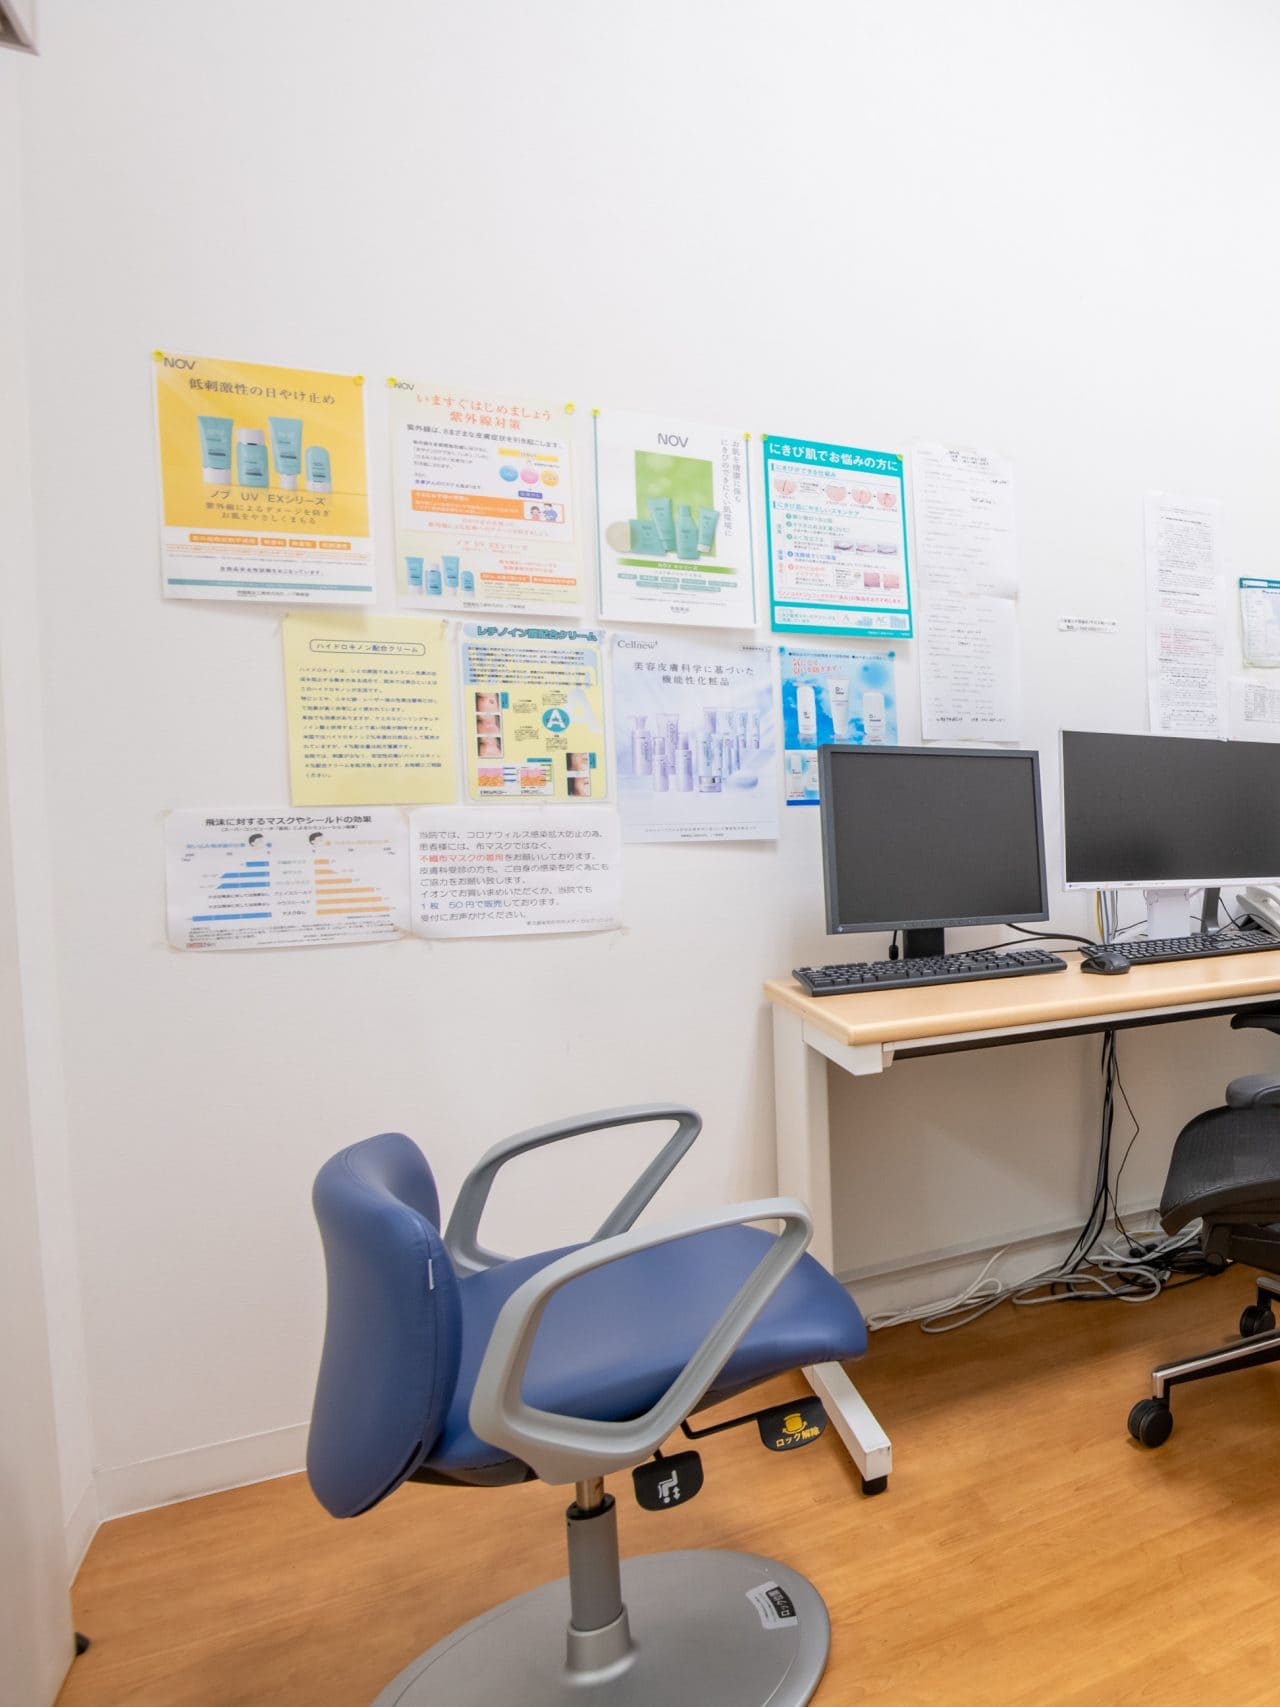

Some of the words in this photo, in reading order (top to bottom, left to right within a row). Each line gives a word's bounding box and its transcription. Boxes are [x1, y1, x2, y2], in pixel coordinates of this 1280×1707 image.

[163, 357, 196, 370] NOV
[188, 378, 336, 405] 低刺激性の日やけ止め
[416, 393, 552, 421] いますぐはじめましょう
[449, 411, 521, 431] 紫外線対策
[657, 432, 689, 448] NOV
[769, 442, 898, 472] にきび肌でお悩みの方に
[210, 489, 231, 500] ノブ
[241, 493, 259, 501] UV
[267, 494, 326, 506] EXシリーズ
[633, 661, 754, 676] 美容皮膚科学に基づいた
[661, 674, 730, 687] 機能性化粧品
[205, 815, 372, 827] 飛沫に対するマスクやシールドの効果
[776, 1426, 820, 1448] ロック解除
